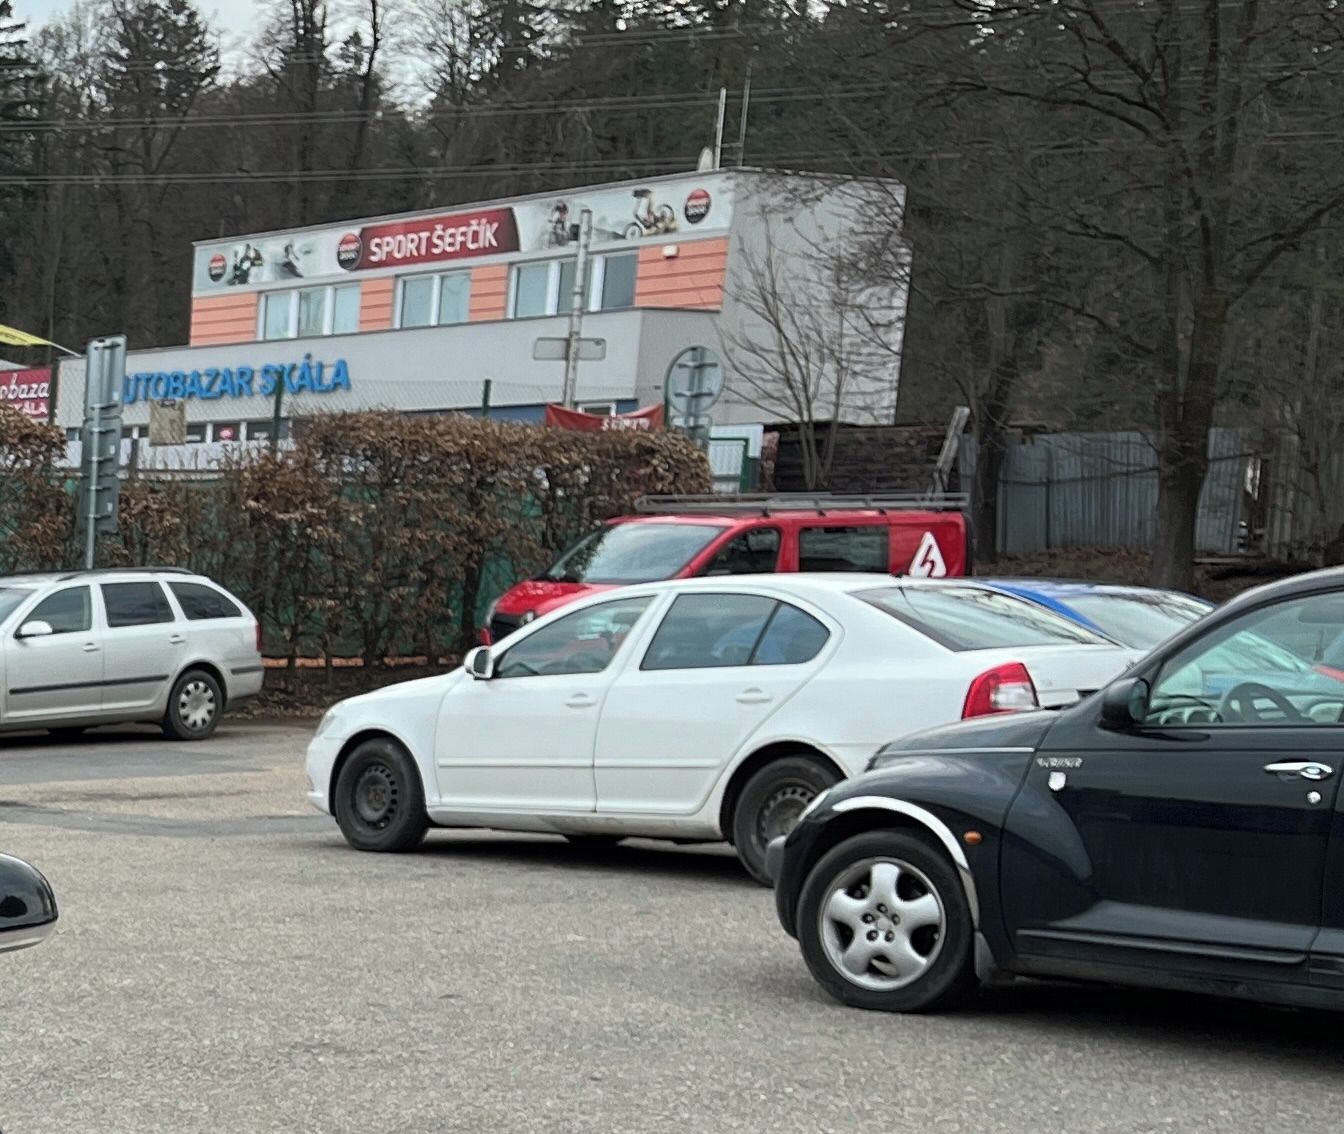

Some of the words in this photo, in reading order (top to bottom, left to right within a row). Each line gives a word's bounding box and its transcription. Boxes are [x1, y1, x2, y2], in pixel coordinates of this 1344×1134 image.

[368, 231, 431, 263] SPORT
[431, 218, 499, 255] ŠEFČÍK
[124, 364, 255, 405] UTOBAZAR
[261, 352, 351, 396] SKÁLA
